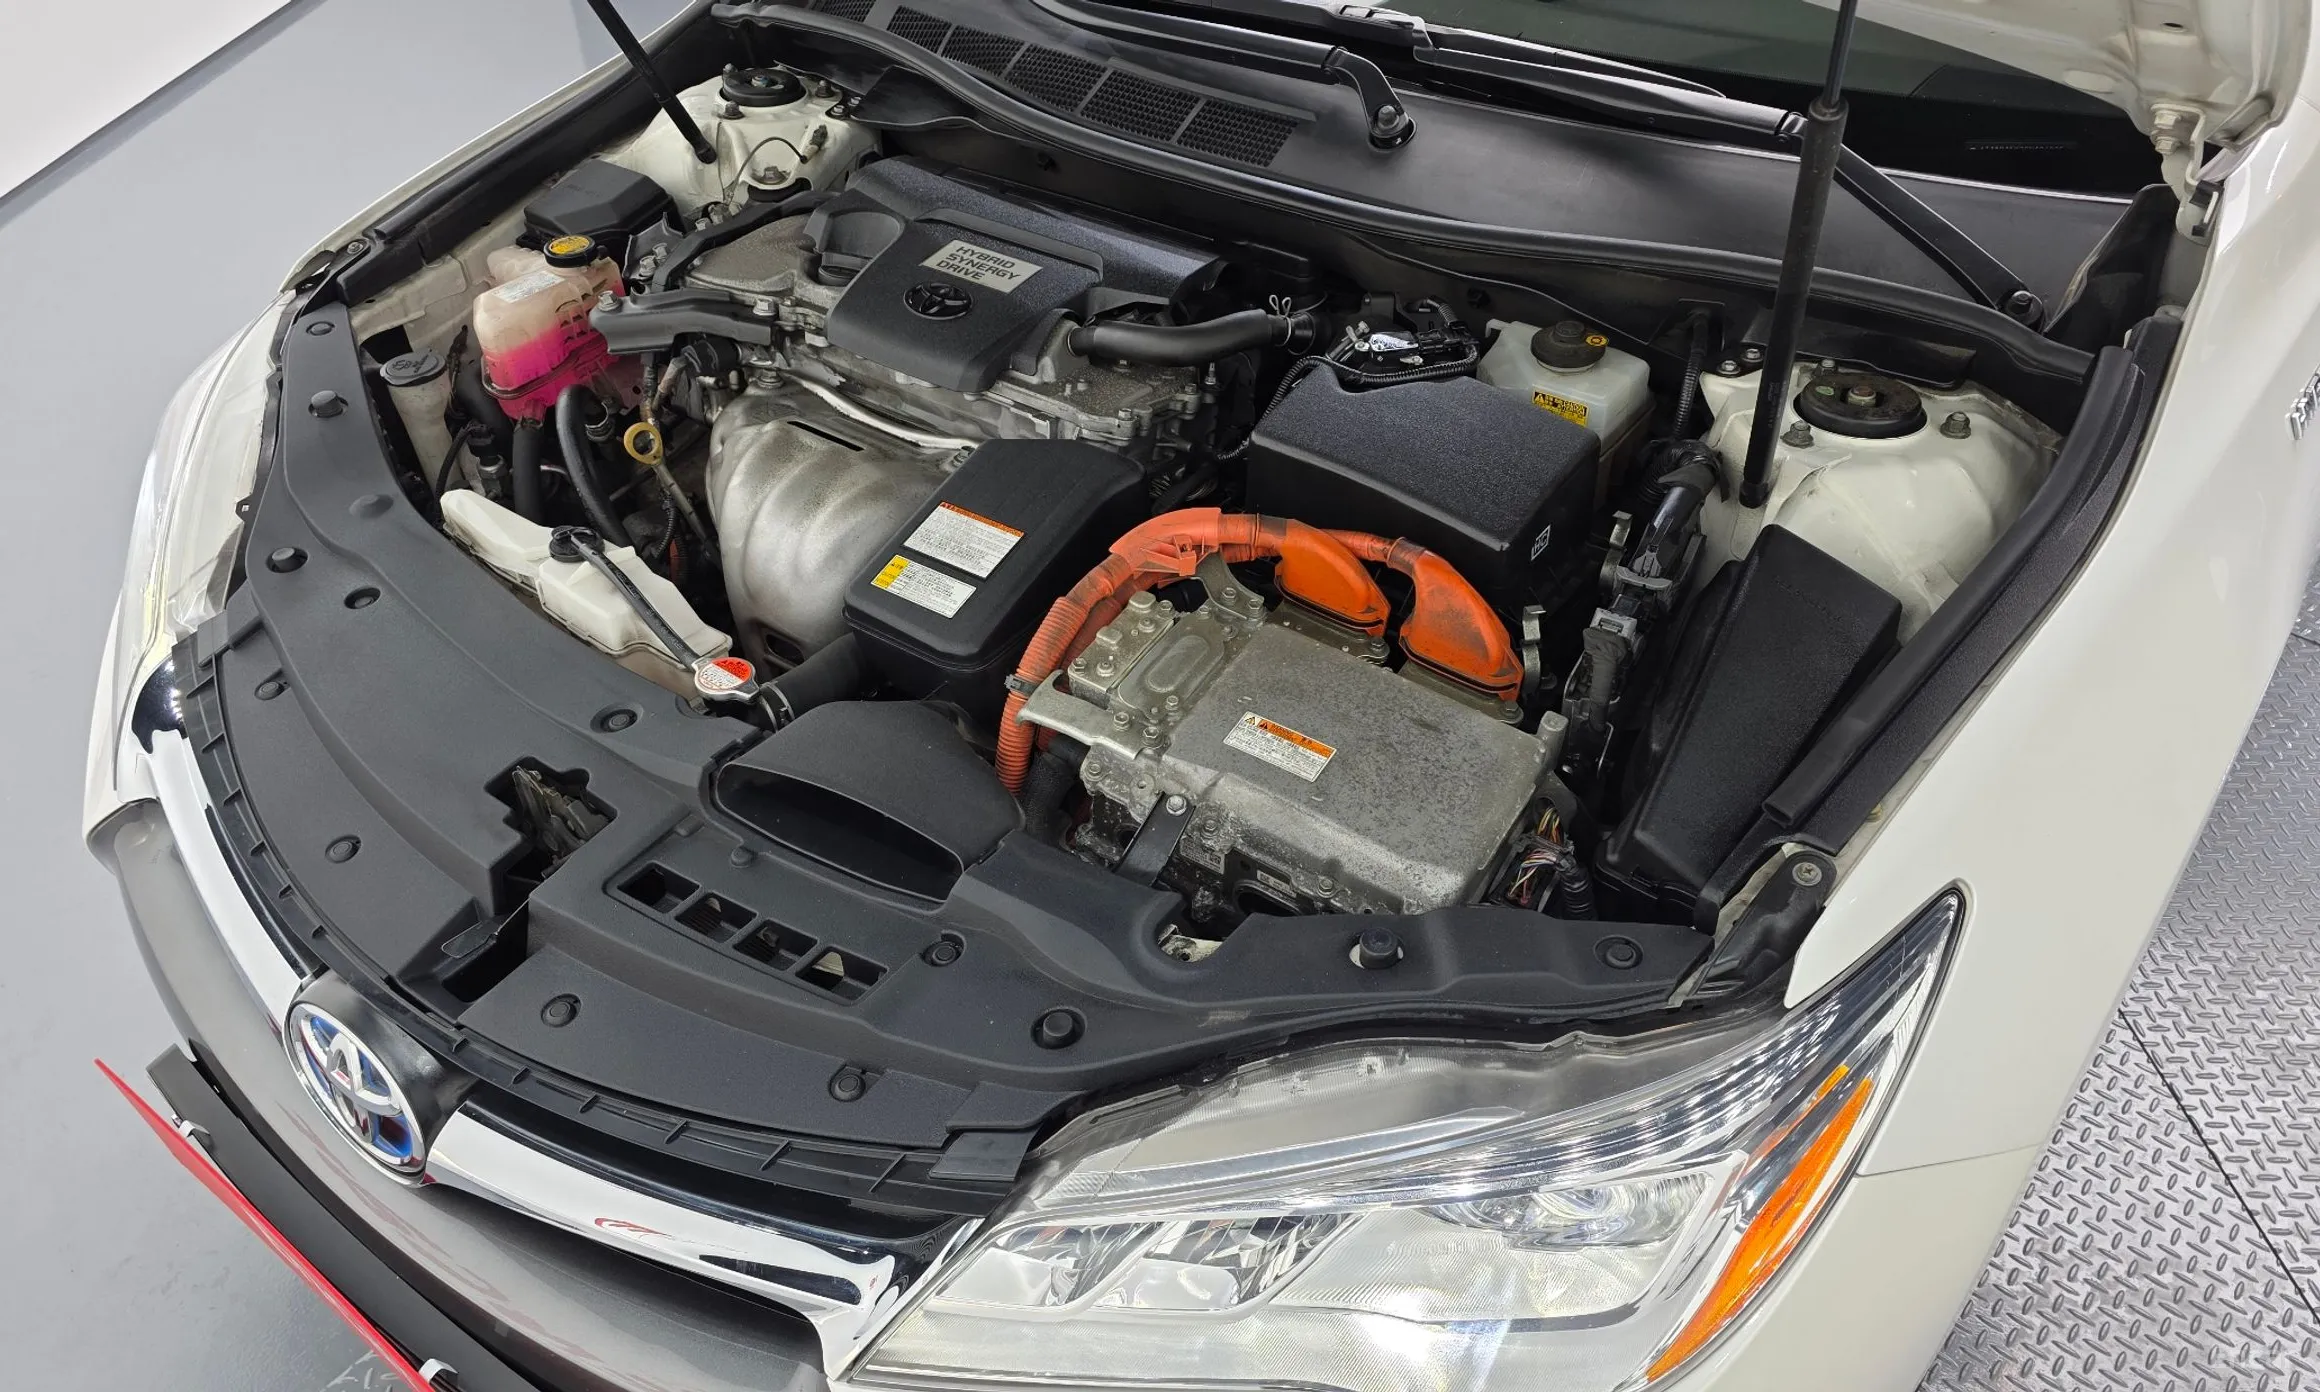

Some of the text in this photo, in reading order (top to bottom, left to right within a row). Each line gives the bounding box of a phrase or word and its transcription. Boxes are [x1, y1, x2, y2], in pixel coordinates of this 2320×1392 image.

[946, 253, 1021, 280] SYNERGY
[956, 246, 1015, 269] HYBRID
[936, 260, 986, 280] DRIVE
